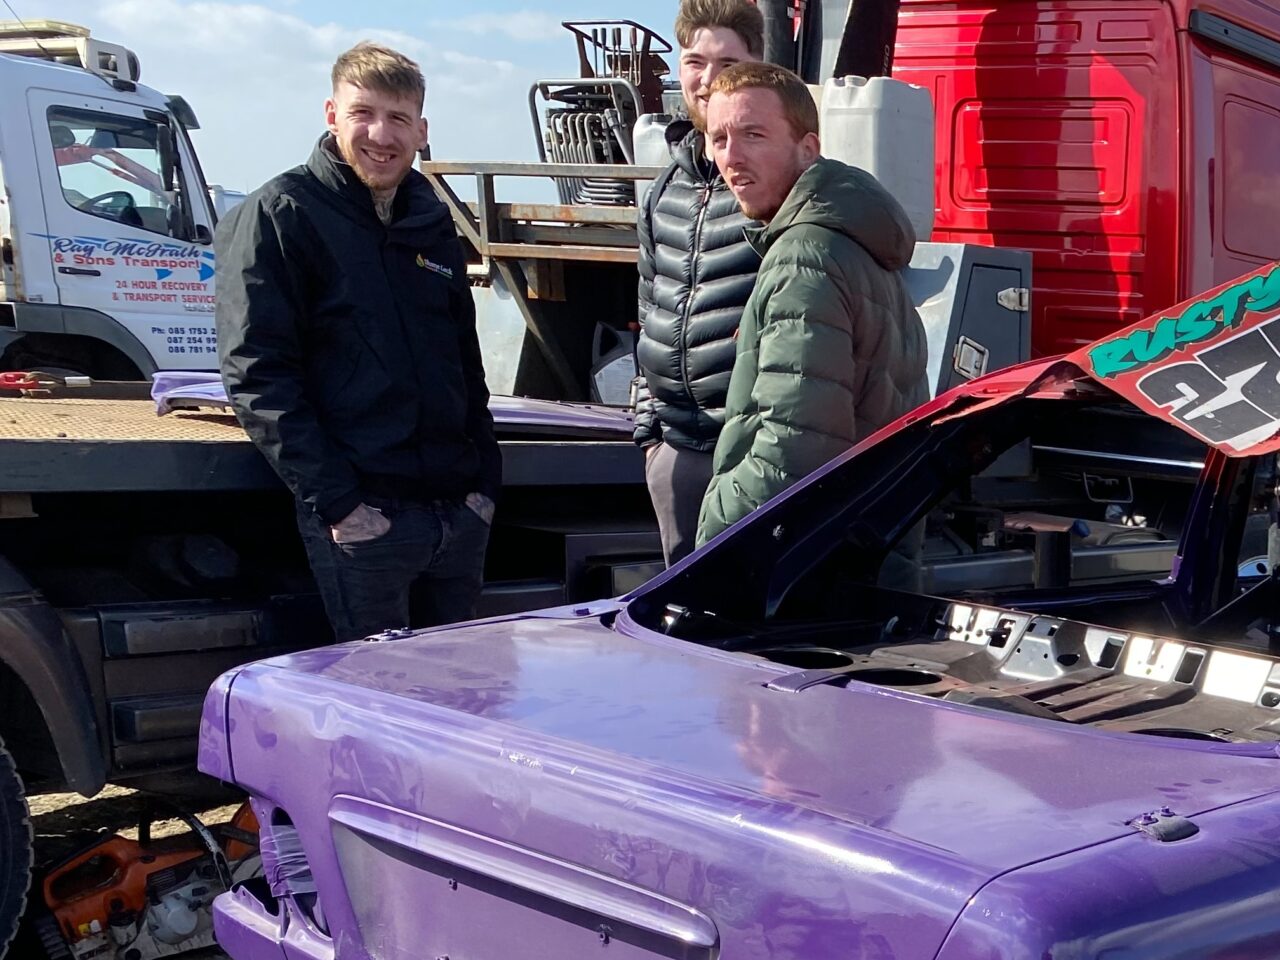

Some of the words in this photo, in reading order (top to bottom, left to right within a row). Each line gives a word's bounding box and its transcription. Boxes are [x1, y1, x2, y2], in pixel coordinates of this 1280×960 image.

[53, 238, 95, 258] Ray
[103, 241, 199, 258] McGrath
[54, 253, 64, 264] &
[75, 254, 115, 266] Sons
[122, 256, 199, 269] Transport
[115, 280, 127, 289] 24
[132, 280, 157, 290] HOUR
[162, 281, 207, 292] RECOVERY
[123, 292, 177, 303] TRANSPORT
[167, 336, 183, 344] 087
